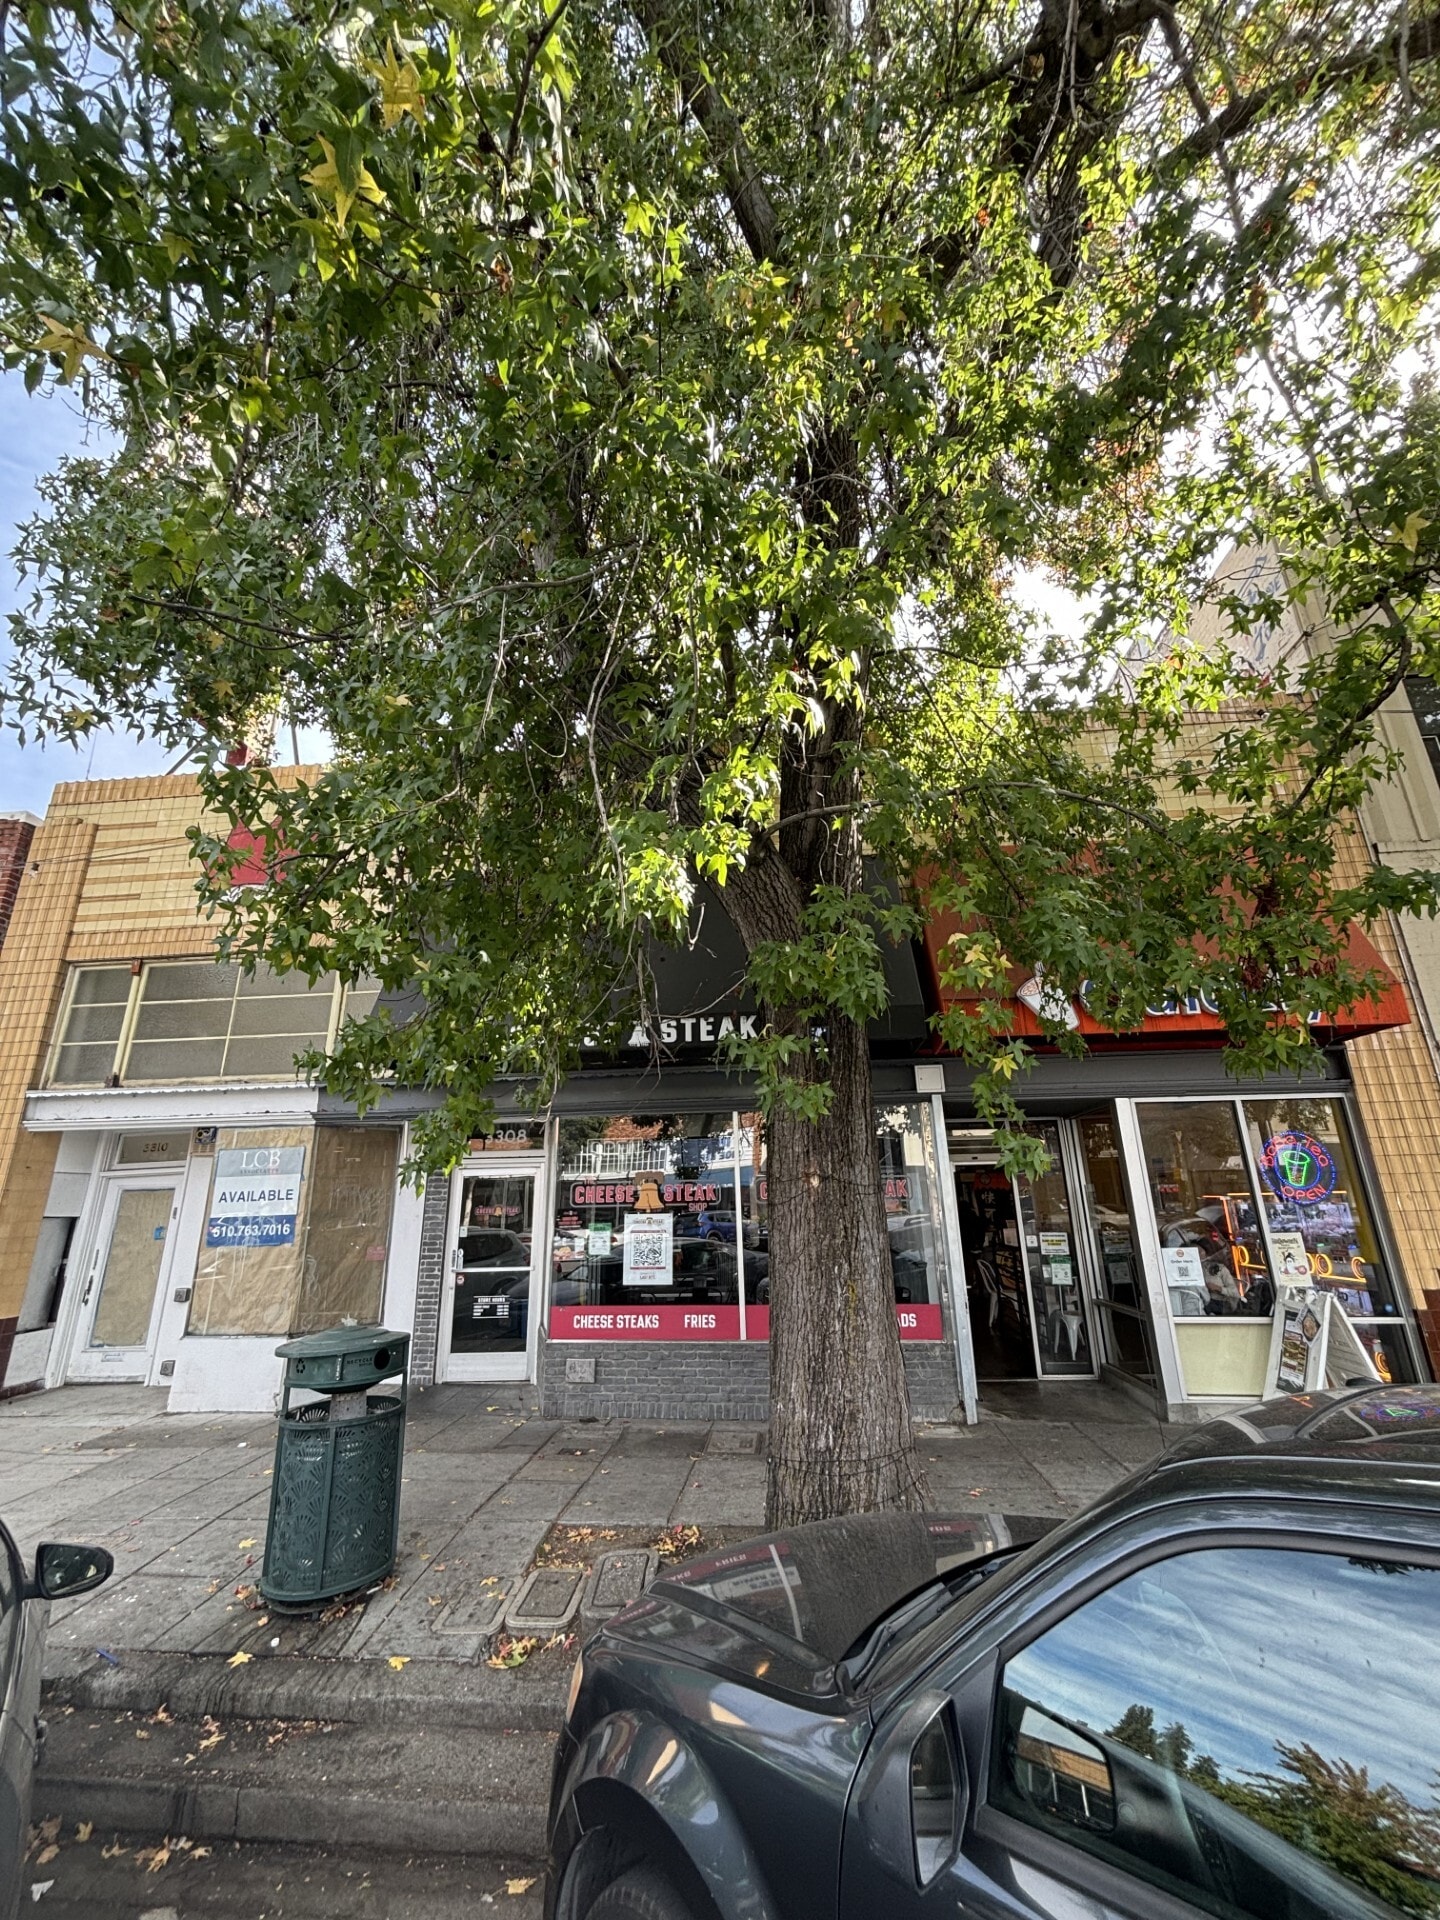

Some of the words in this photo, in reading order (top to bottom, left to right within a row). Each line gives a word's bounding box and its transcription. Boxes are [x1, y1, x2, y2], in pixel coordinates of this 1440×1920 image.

[660, 1014, 758, 1044] STEAK
[239, 1150, 281, 1169] LCB
[218, 1188, 295, 1204] AVAILABLE
[574, 1185, 635, 1204] CHEESE
[663, 1183, 717, 1202] STEAK
[1281, 1183, 1327, 1200] OPEN
[688, 1202, 708, 1212] SHOP
[212, 1223, 291, 1239] 510.763.7016
[573, 1314, 614, 1329] CHEESE
[616, 1314, 660, 1329] STEAKS
[684, 1314, 716, 1329] FRIES
